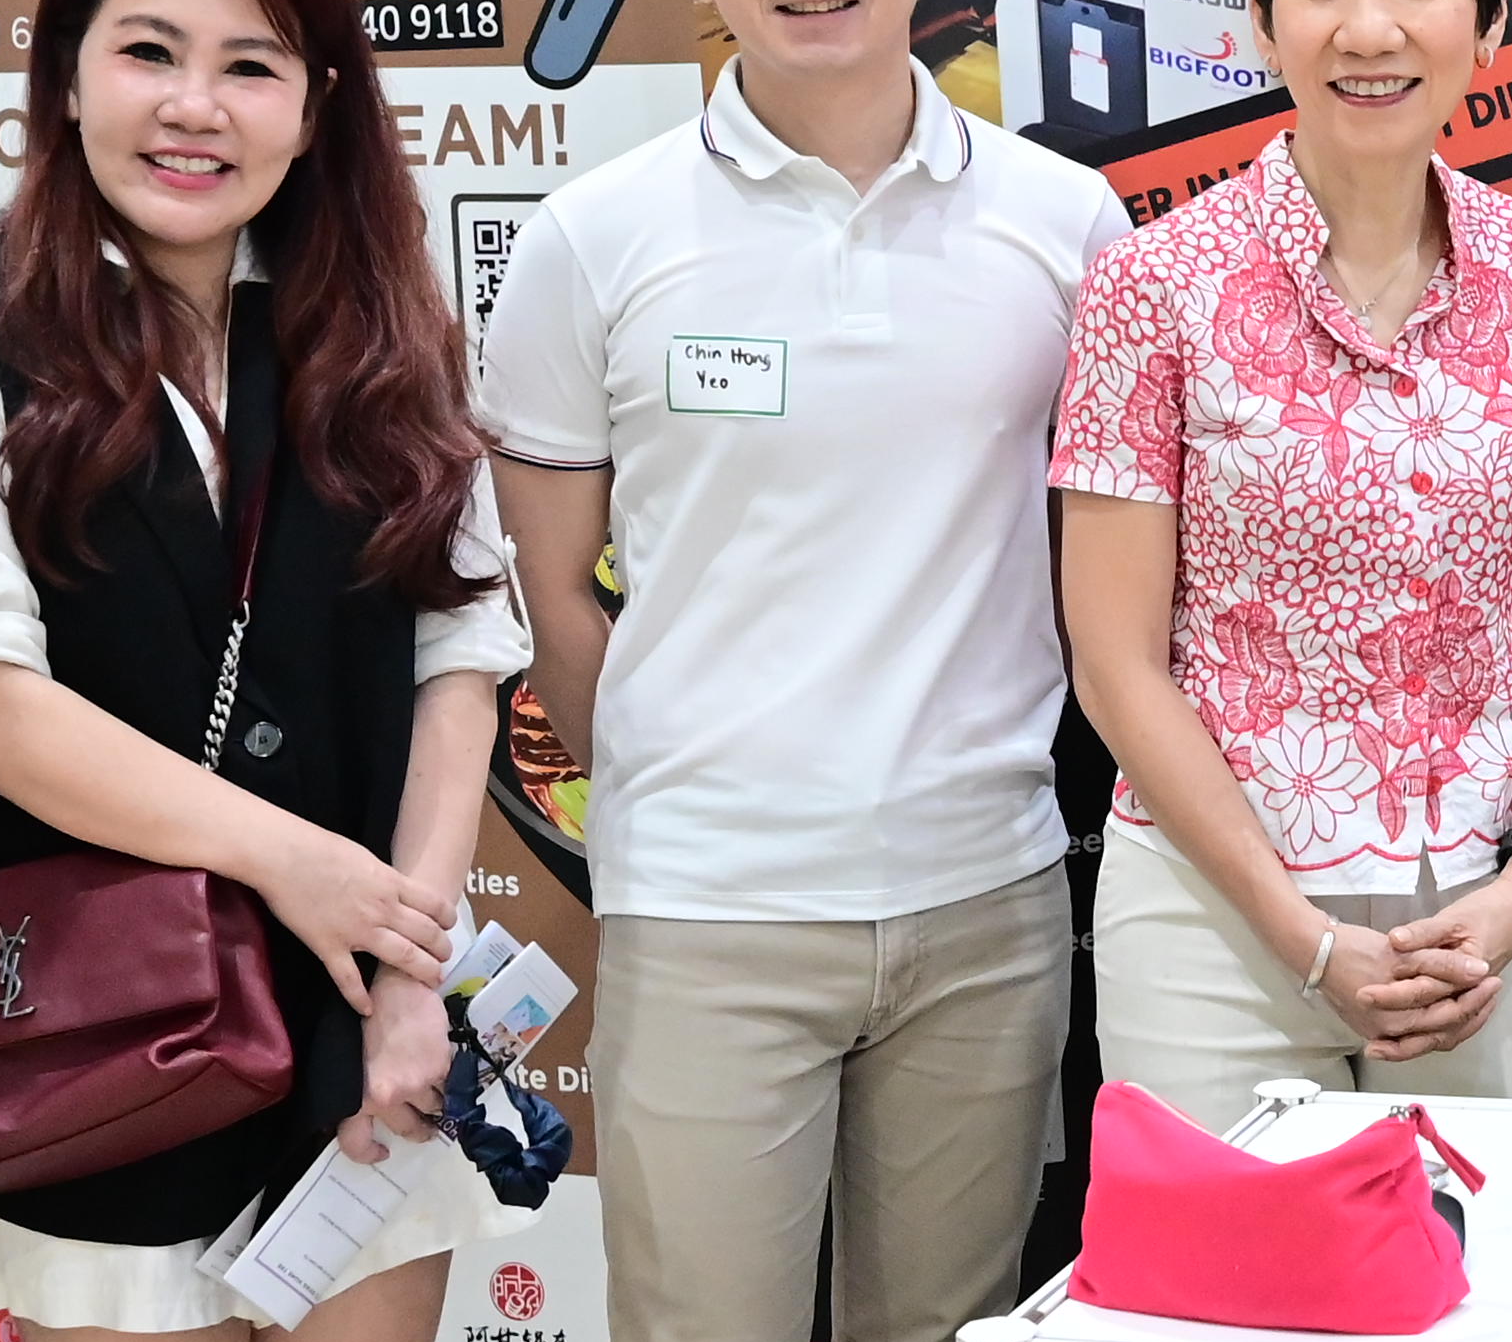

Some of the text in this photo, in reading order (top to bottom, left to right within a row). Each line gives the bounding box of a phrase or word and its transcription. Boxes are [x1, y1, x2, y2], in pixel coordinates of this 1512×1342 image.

[410, 1, 499, 40] 9118
[1149, 47, 1266, 87] BIGFOOT
[685, 345, 722, 360] Chin
[696, 370, 729, 389] Yeo
